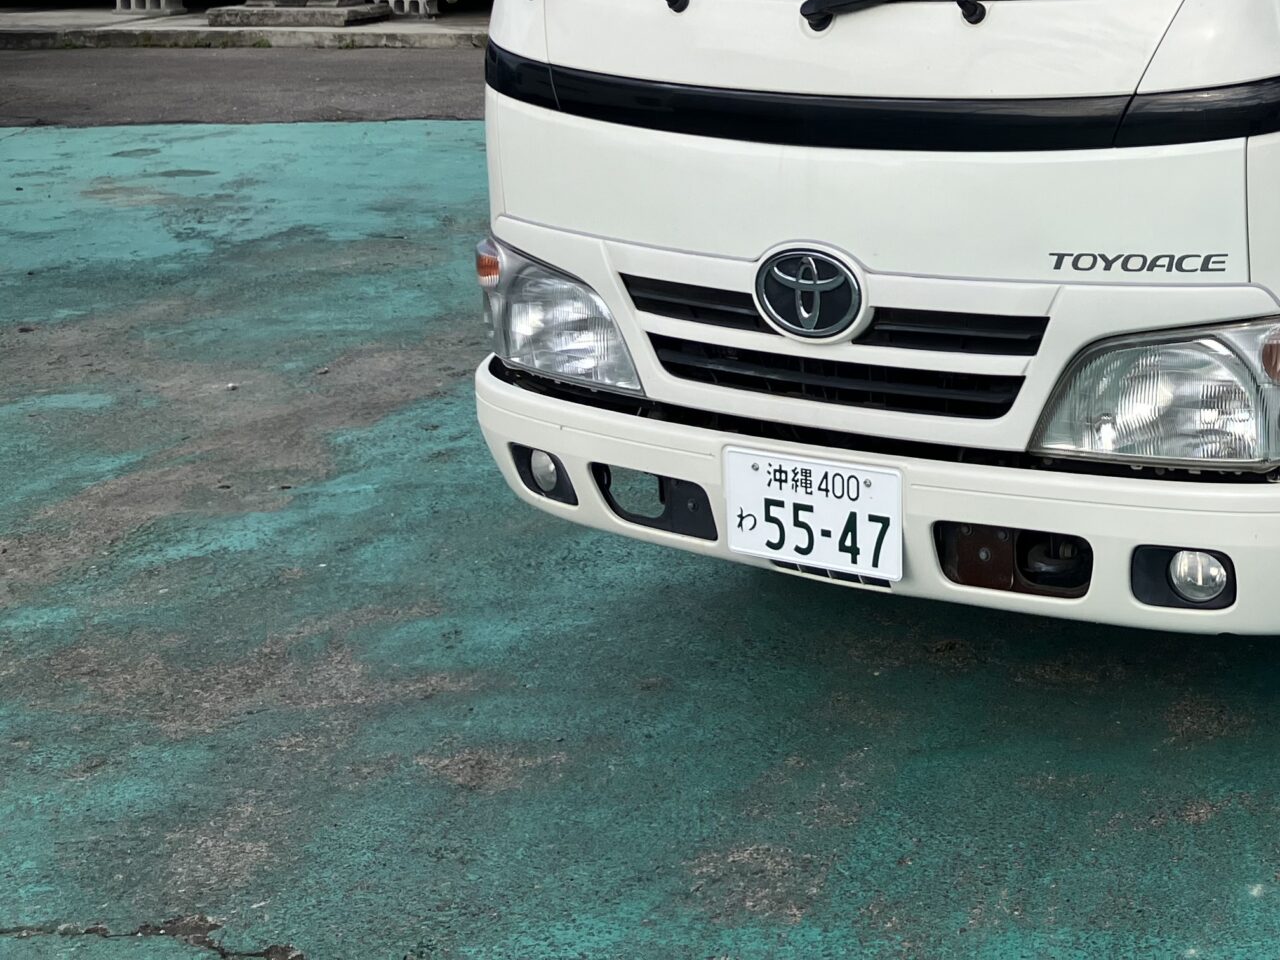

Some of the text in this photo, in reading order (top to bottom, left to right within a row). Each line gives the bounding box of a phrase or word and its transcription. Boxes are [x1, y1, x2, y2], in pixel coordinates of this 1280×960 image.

[1048, 252, 1229, 273] TOYOACE
[737, 497, 891, 569] わ 55-47
